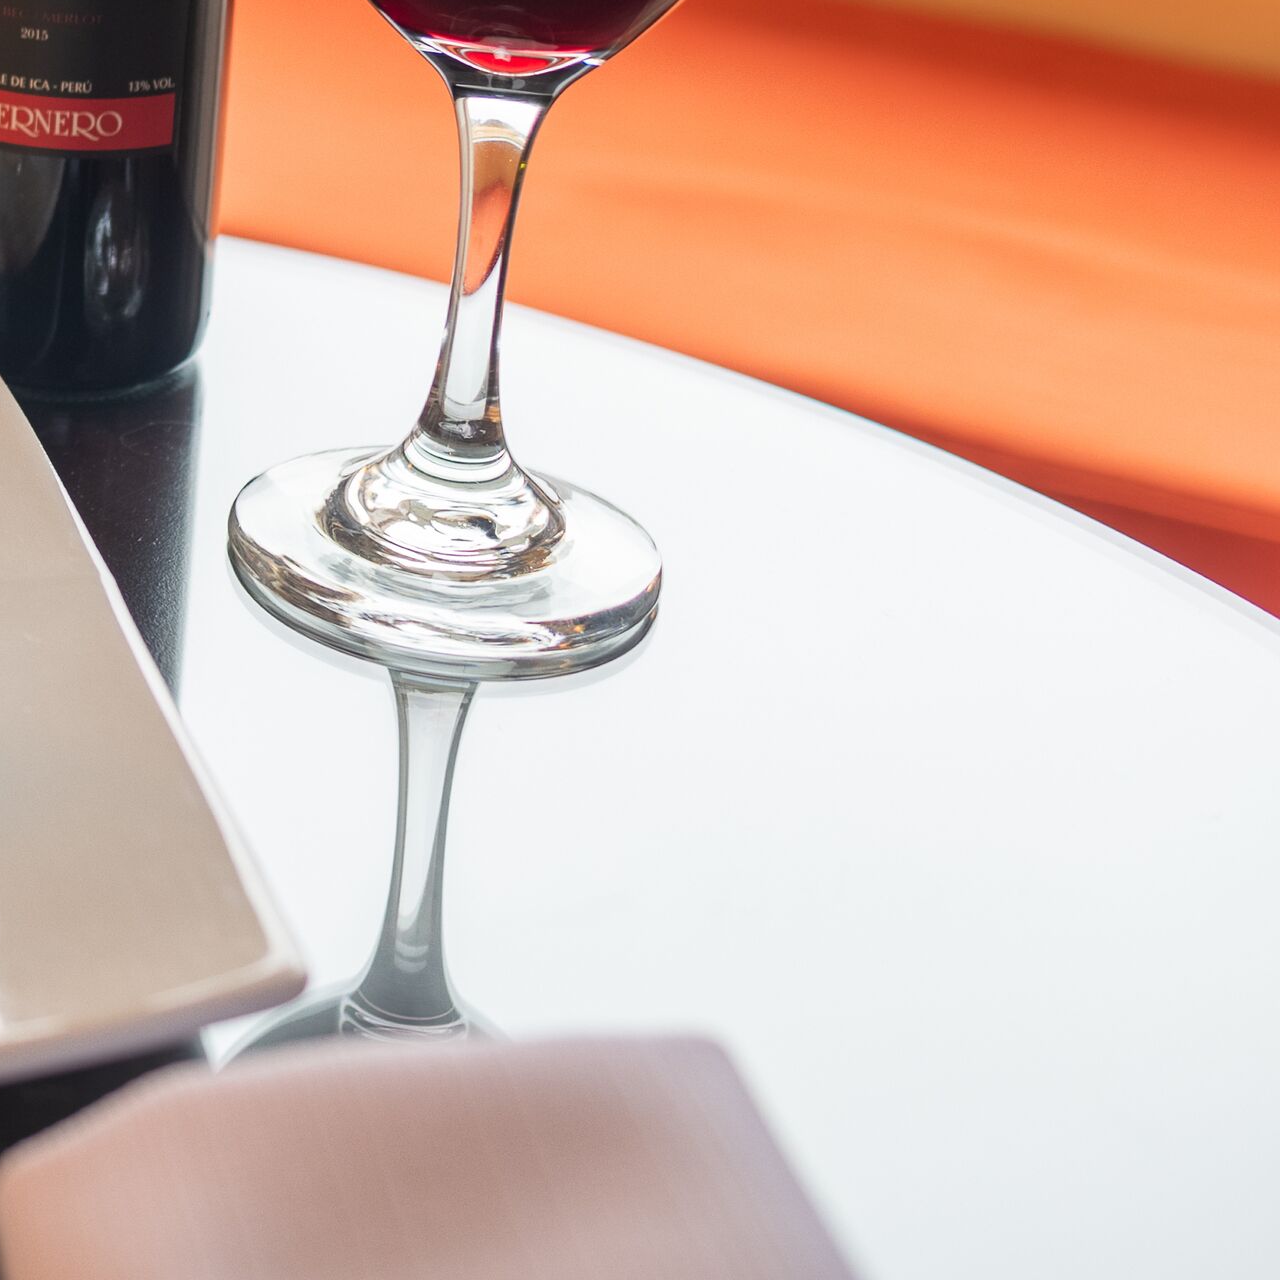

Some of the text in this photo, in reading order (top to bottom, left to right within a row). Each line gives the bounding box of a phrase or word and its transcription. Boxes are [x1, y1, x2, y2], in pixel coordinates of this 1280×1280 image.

[20, 26, 49, 41] 2015
[10, 75, 26, 89] DE
[29, 77, 50, 91] ICA
[128, 79, 151, 93] 13%
